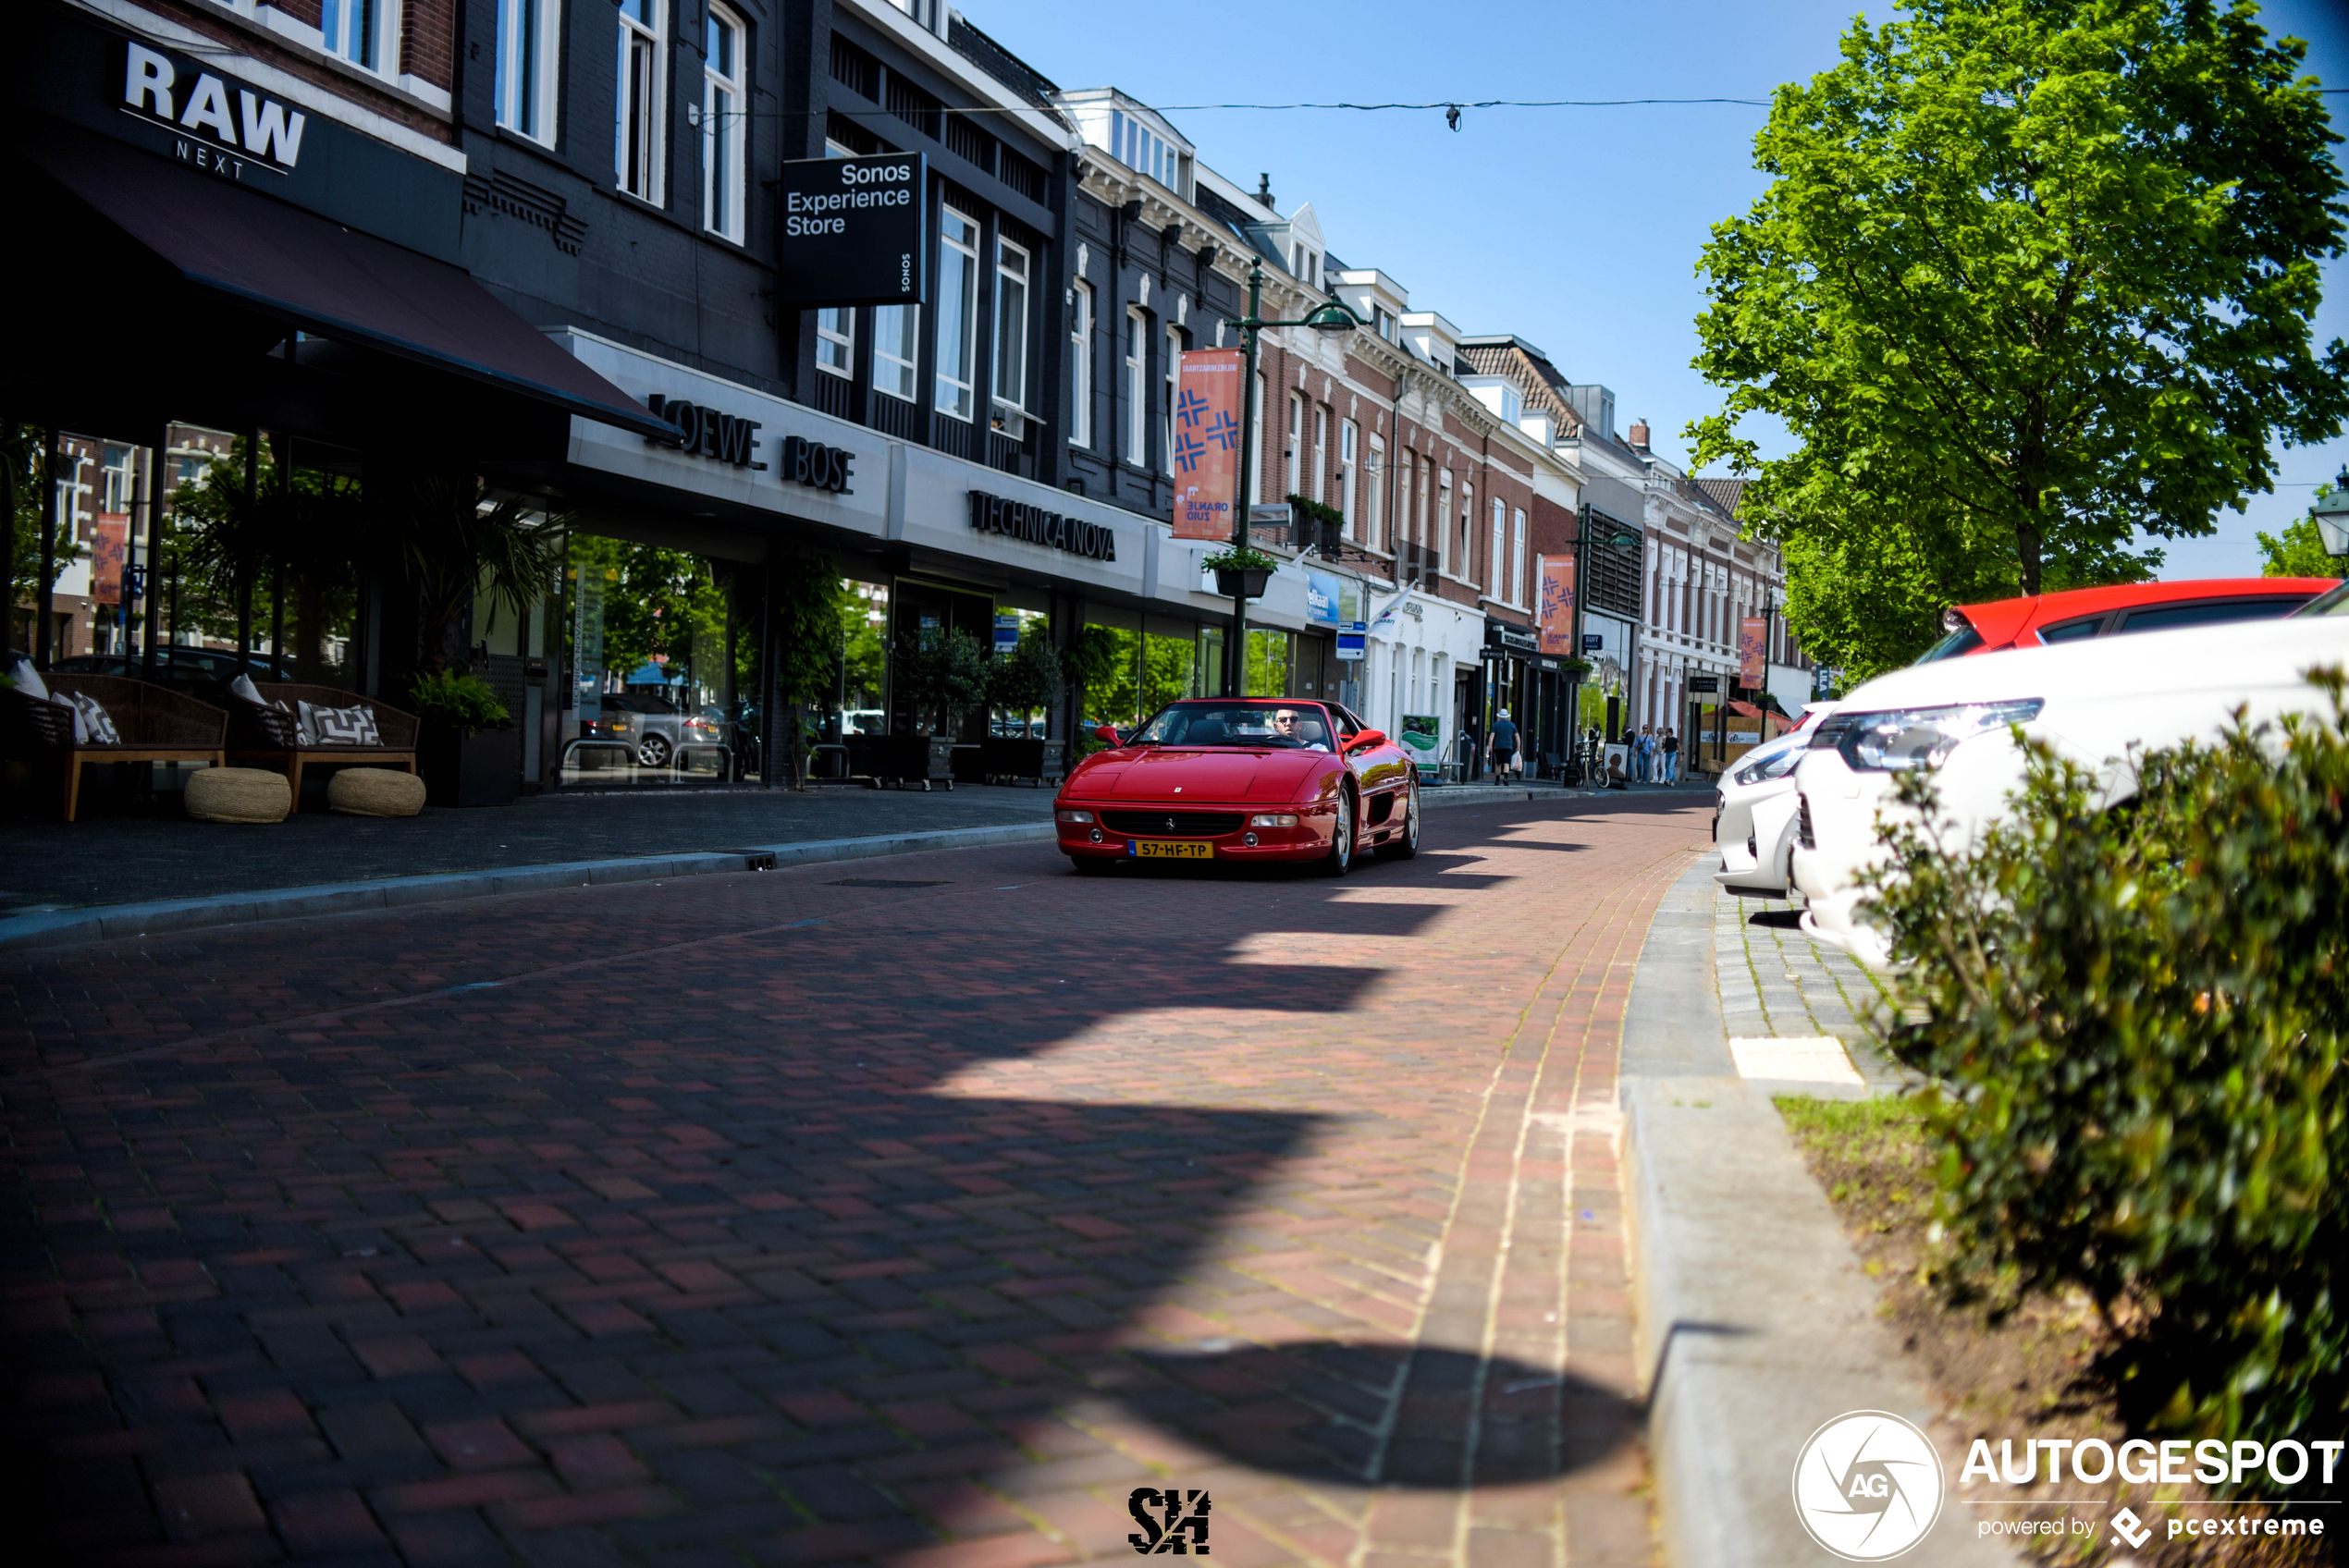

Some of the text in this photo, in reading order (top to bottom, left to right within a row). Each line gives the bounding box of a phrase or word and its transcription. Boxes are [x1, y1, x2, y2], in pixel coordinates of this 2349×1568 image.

[125, 41, 305, 167] RAW
[177, 140, 242, 178] NEXT
[842, 164, 911, 185] Sonos
[787, 188, 911, 215] Experience
[786, 215, 845, 236] Store
[902, 252, 911, 292] SONOS
[782, 435, 855, 496] BOSE
[968, 490, 1116, 562] TECHNICA NOVA
[572, 659, 581, 709] TECHNICA
[1819, 669, 1828, 692] LILA
[1142, 843, 1206, 856] 57-HF-TP
